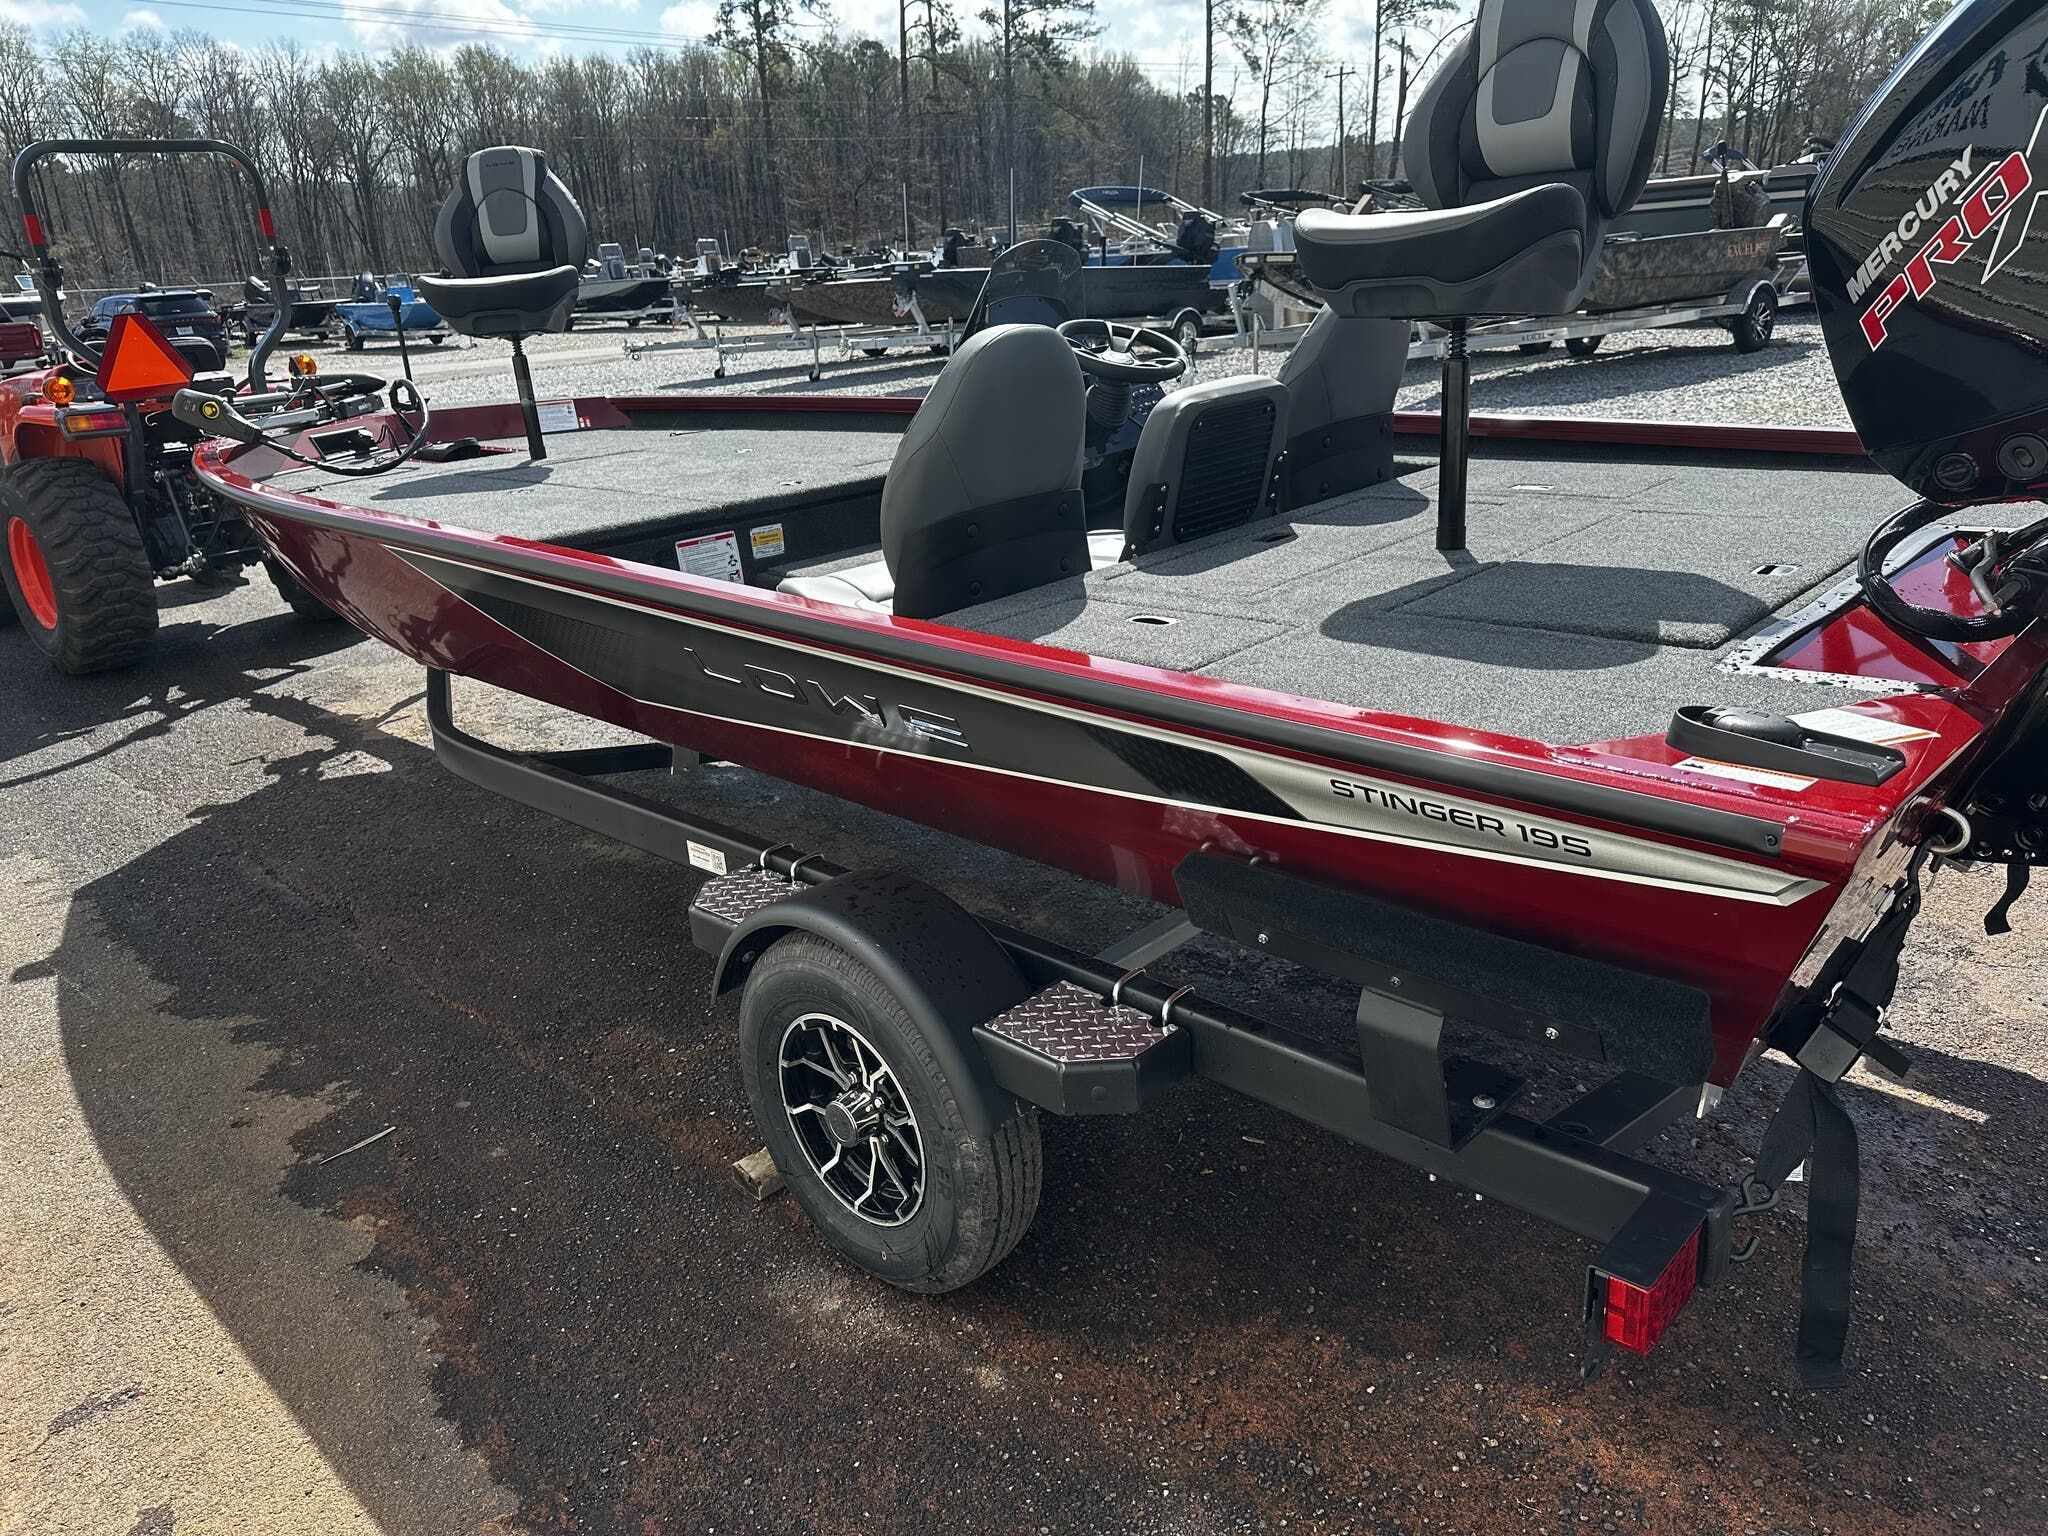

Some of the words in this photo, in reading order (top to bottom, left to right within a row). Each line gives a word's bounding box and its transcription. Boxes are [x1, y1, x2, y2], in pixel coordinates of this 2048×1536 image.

[1846, 143, 1974, 304] MERCURY
[1859, 151, 2033, 353] PRO
[684, 646, 974, 752] LOWE
[1330, 779, 1508, 837] STINGER
[1516, 823, 1592, 857] 195
